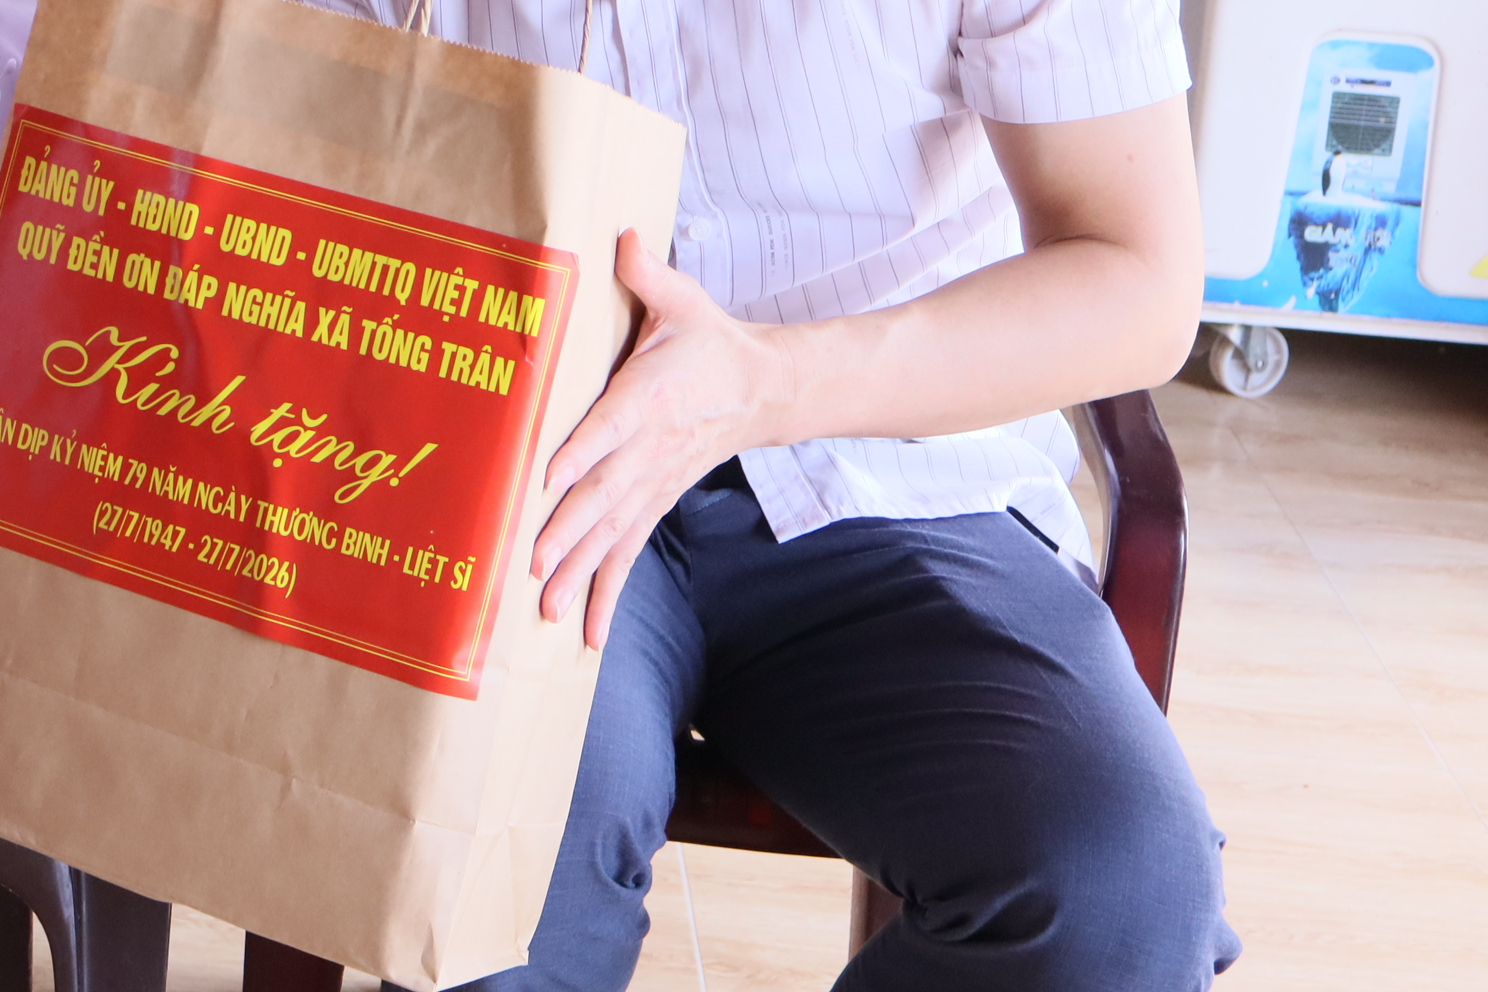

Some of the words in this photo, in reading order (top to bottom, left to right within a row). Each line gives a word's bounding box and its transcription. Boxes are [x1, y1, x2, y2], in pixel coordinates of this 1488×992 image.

[17, 221, 66, 265] QUỸ
[67, 230, 119, 282] ĐỀN
[122, 253, 161, 295] ƠN
[163, 264, 218, 310] ĐÁP
[221, 281, 306, 338] NGHĨA
[311, 306, 353, 350] XÃ
[359, 314, 432, 372] TỐNG
[438, 341, 516, 396] TRÂN
[18, 145, 79, 207] ĐẢNG
[82, 159, 115, 216] ỦY
[130, 189, 200, 241] HĐND
[219, 213, 293, 266] UBND
[312, 239, 417, 306] UBMTTQ
[420, 267, 480, 322] VIỆT
[478, 284, 546, 337] NAM
[42, 326, 246, 434] Kính
[250, 402, 439, 504] tặng!
[17, 423, 49, 460] DỊP
[50, 429, 79, 465] KỶ
[77, 442, 123, 483] NIỆM
[124, 459, 147, 488] 79
[148, 465, 193, 504] NĂM
[194, 482, 252, 522] NGÀY
[255, 500, 338, 550] THƯƠNG
[340, 527, 391, 566] BINH
[402, 544, 449, 587] LIỆT
[450, 556, 477, 591] SĨ
[93, 501, 186, 553] (27/7/1947
[197, 535, 298, 599] 27/7/2026)
